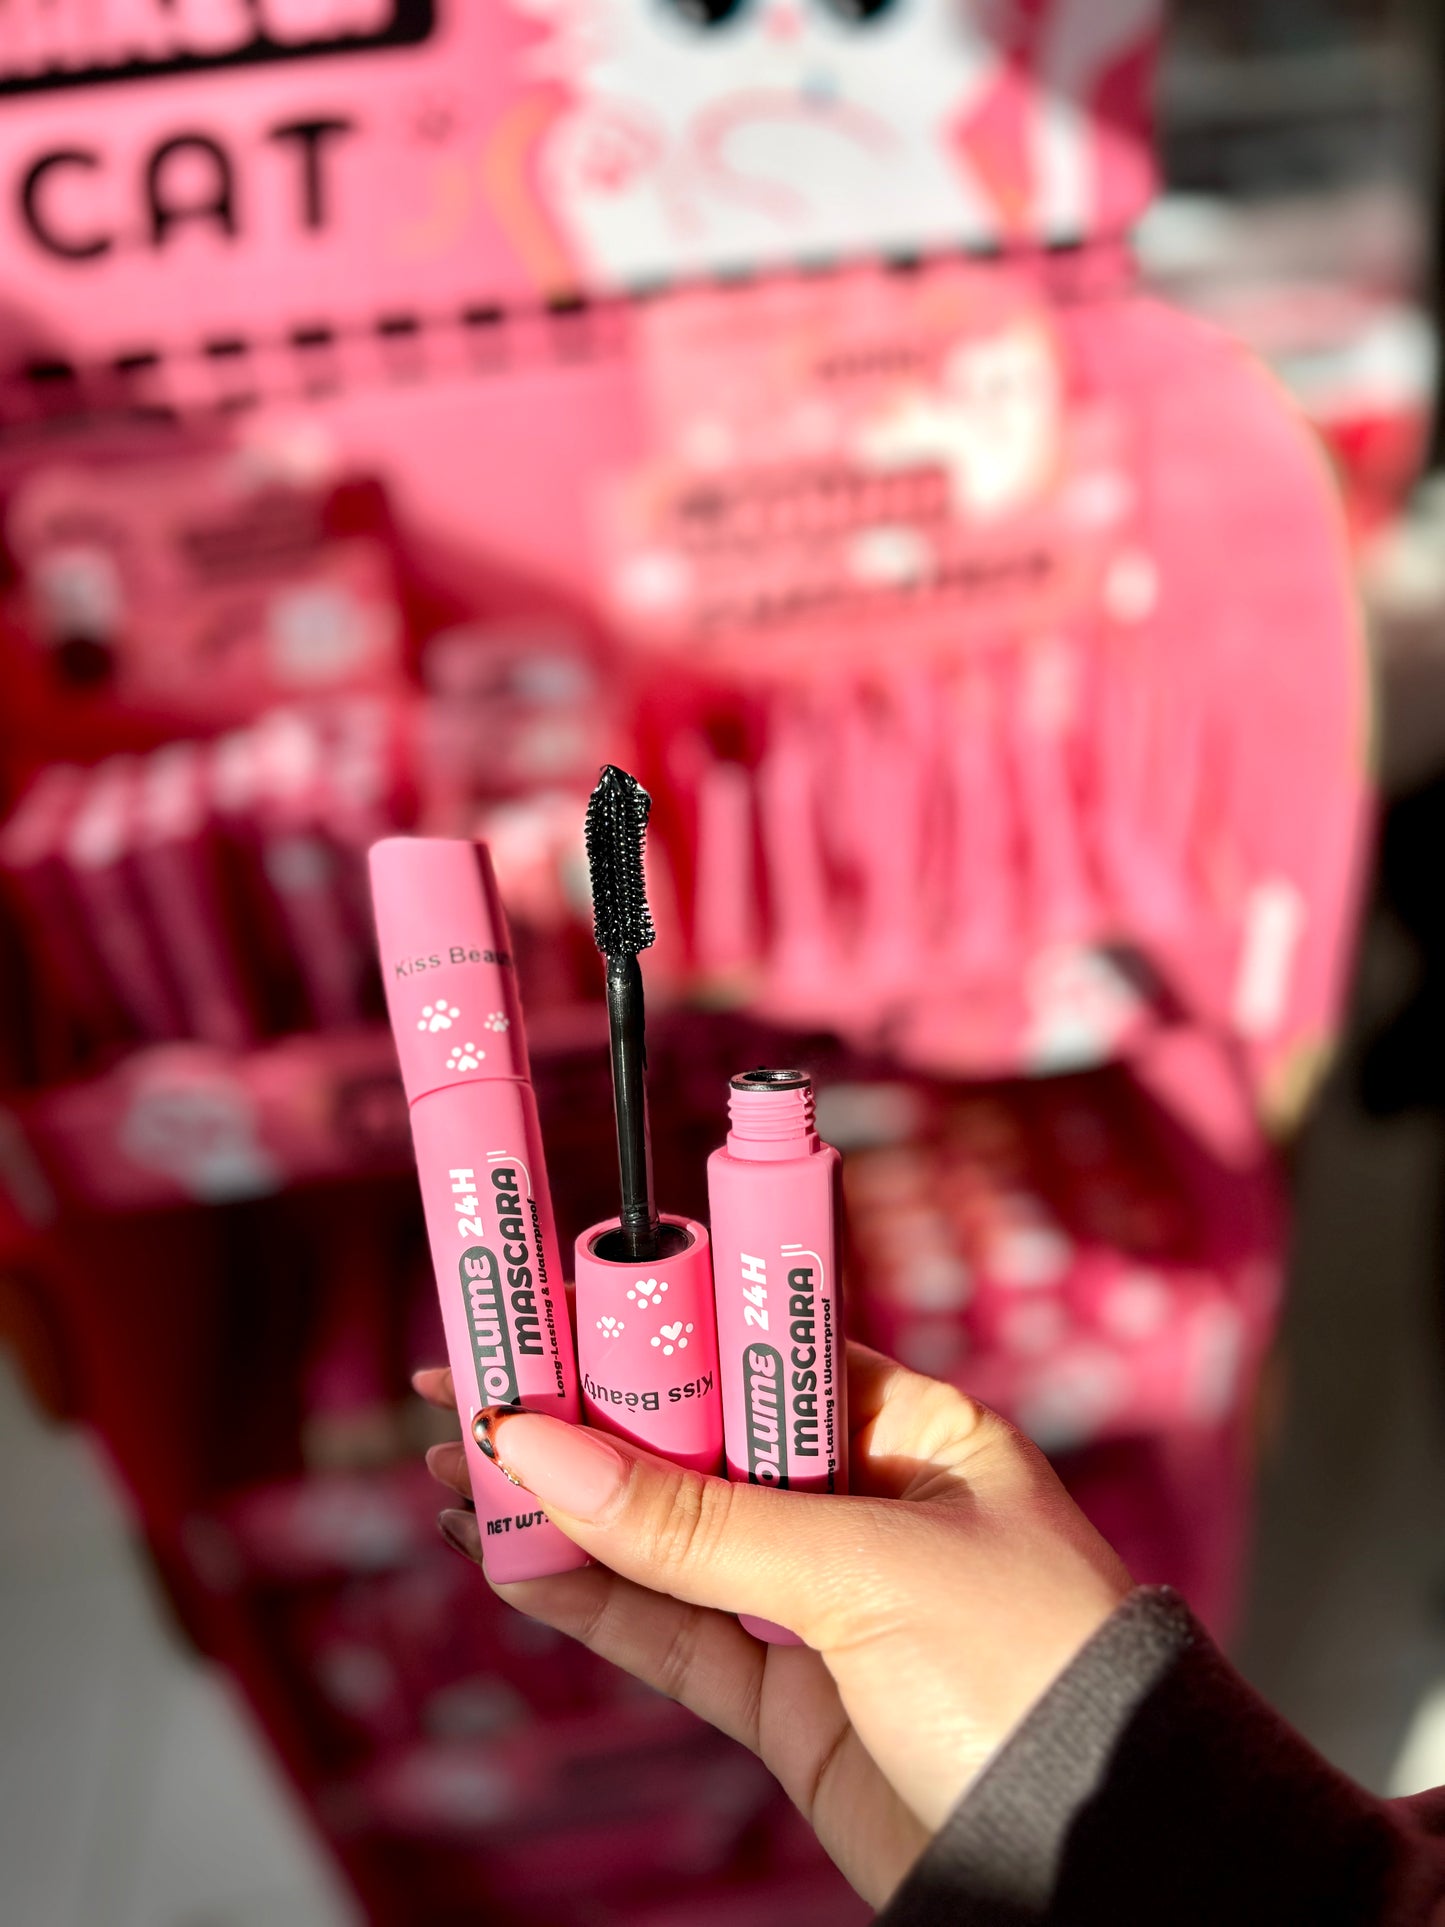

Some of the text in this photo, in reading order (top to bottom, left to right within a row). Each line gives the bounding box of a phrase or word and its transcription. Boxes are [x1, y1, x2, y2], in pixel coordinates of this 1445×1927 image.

[19, 116, 357, 262] CAT
[395, 955, 442, 980] Kiss
[449, 1168, 484, 1238] 24H
[491, 1167, 544, 1356] MASCARA
[526, 1198, 566, 1398] Long-Lasting & Waterproof
[740, 1253, 781, 1487] OLUME 24H
[788, 1267, 820, 1458] MASCARA
[820, 1298, 835, 1385] Waterproof
[668, 1370, 713, 1403] Kiss
[824, 1386, 833, 1397] &
[486, 1517, 512, 1536] NET
